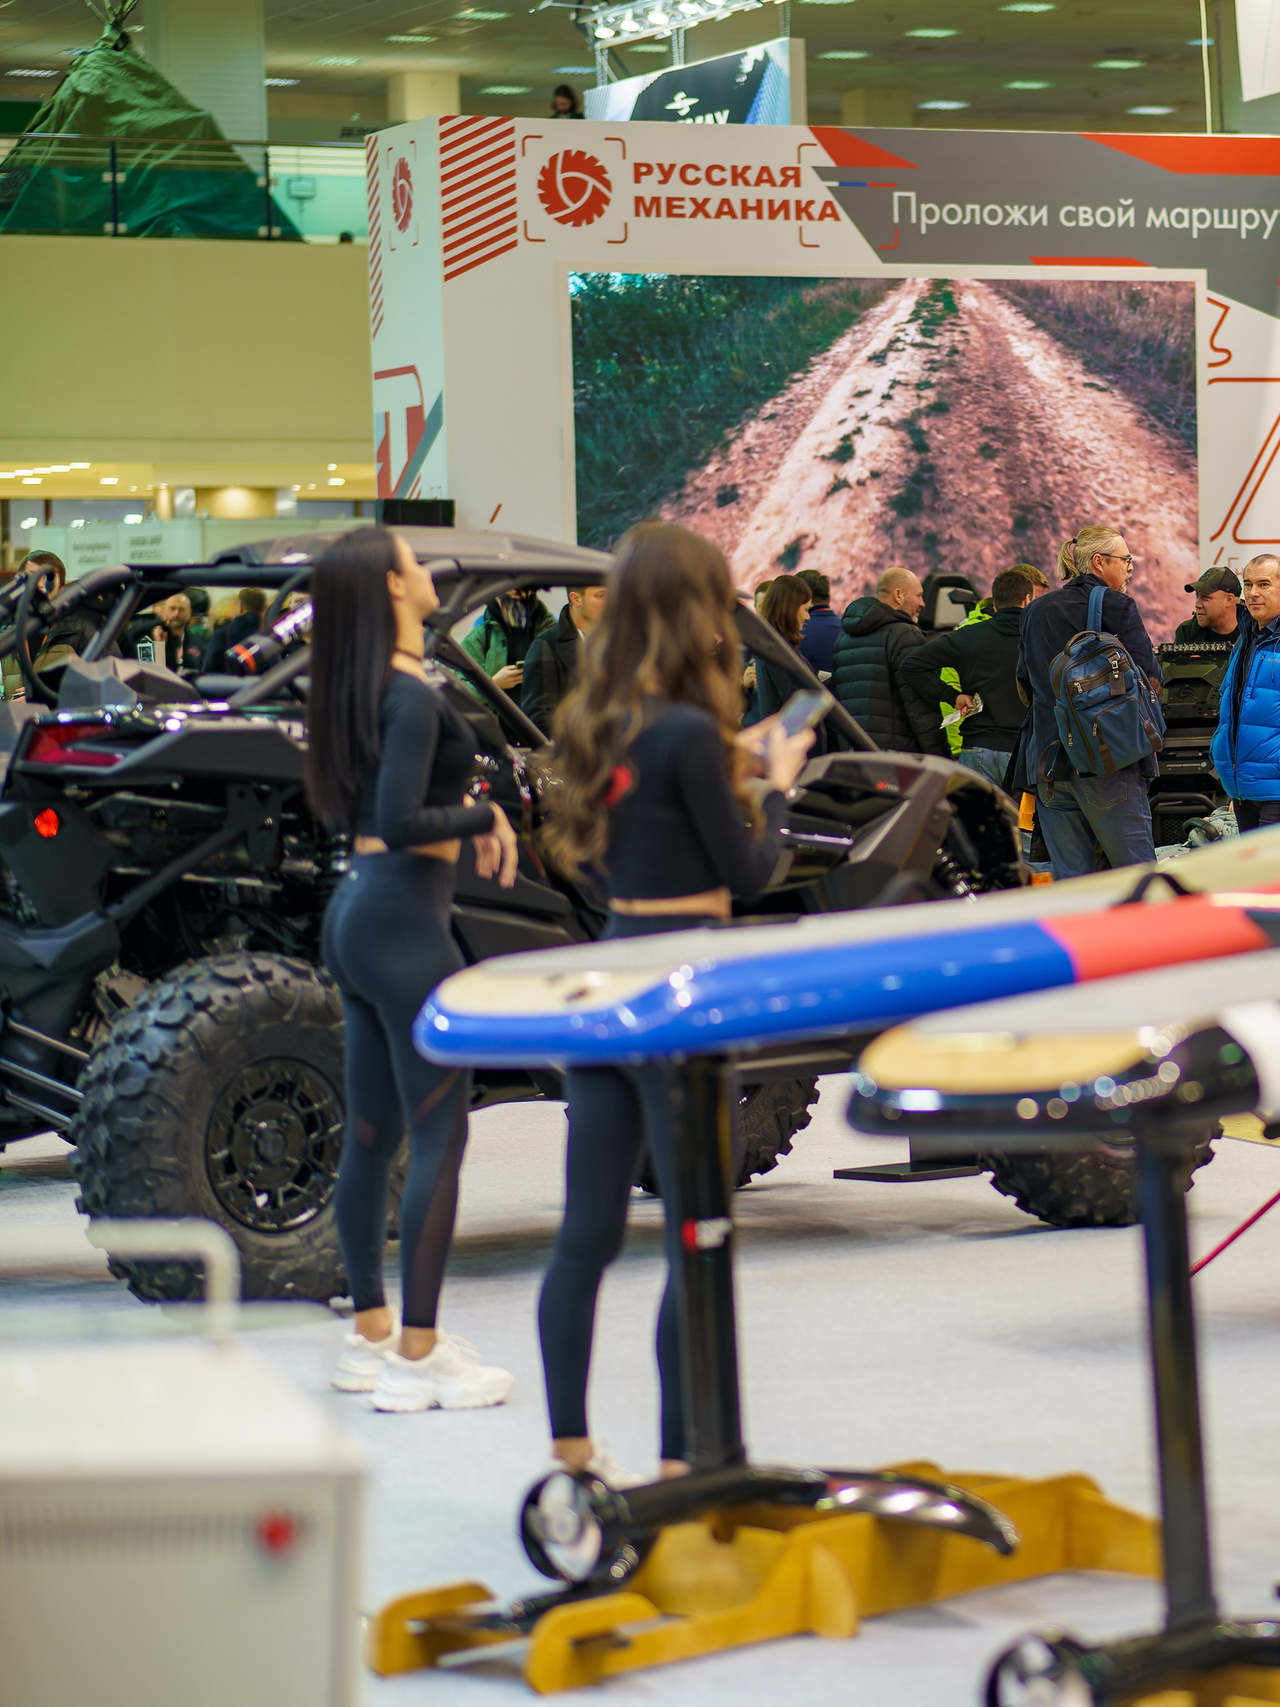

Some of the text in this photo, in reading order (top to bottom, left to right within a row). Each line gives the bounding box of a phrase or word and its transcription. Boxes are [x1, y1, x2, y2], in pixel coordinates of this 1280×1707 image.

[633, 161, 801, 188] РУССКАЯ
[633, 195, 841, 222] МЕХАНИКА
[892, 190, 1049, 235] Проложи
[1058, 198, 1137, 230] свой
